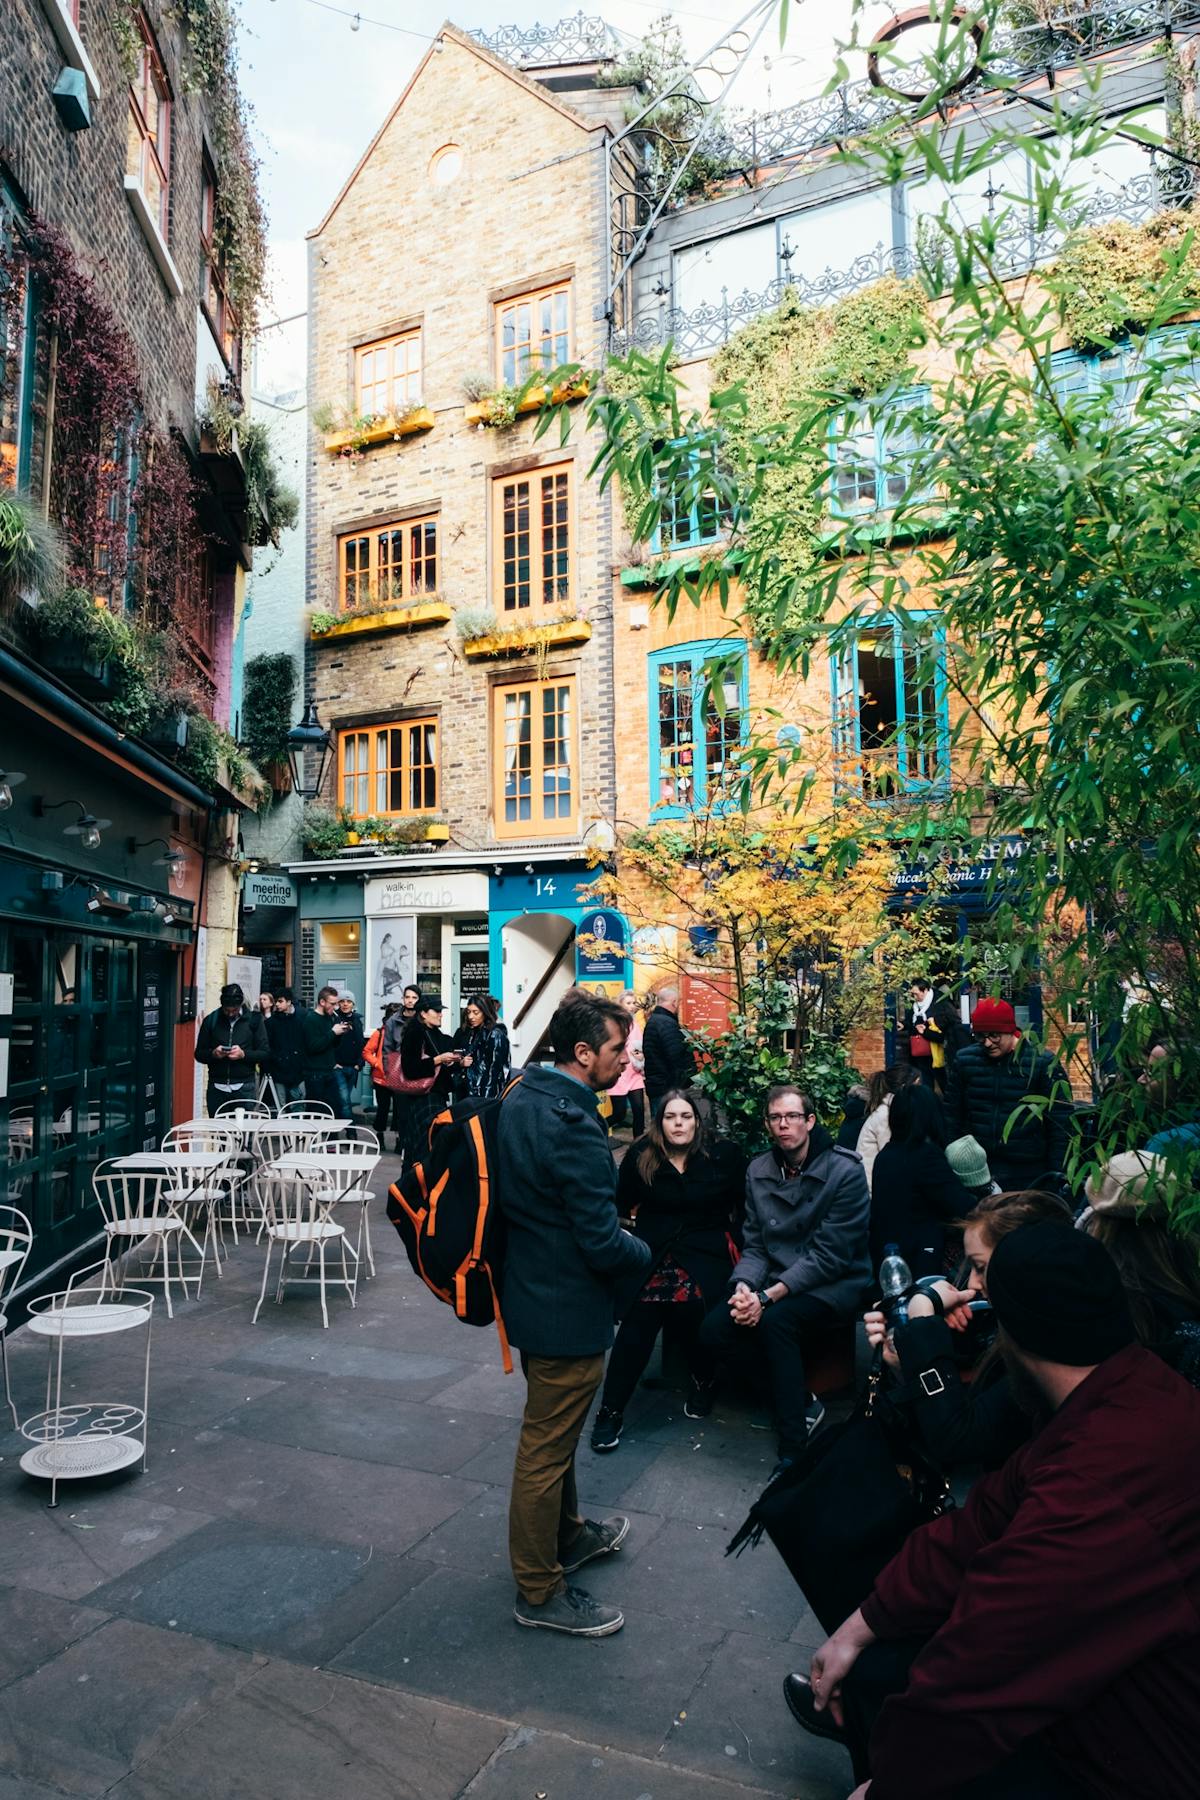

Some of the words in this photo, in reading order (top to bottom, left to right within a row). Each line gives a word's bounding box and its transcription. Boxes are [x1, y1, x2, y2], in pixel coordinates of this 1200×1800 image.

[252, 883, 292, 898] meeting
[385, 882, 414, 892] walk-in
[536, 878, 557, 896] 14
[257, 894, 286, 904] rooms
[381, 886, 453, 907] backrub
